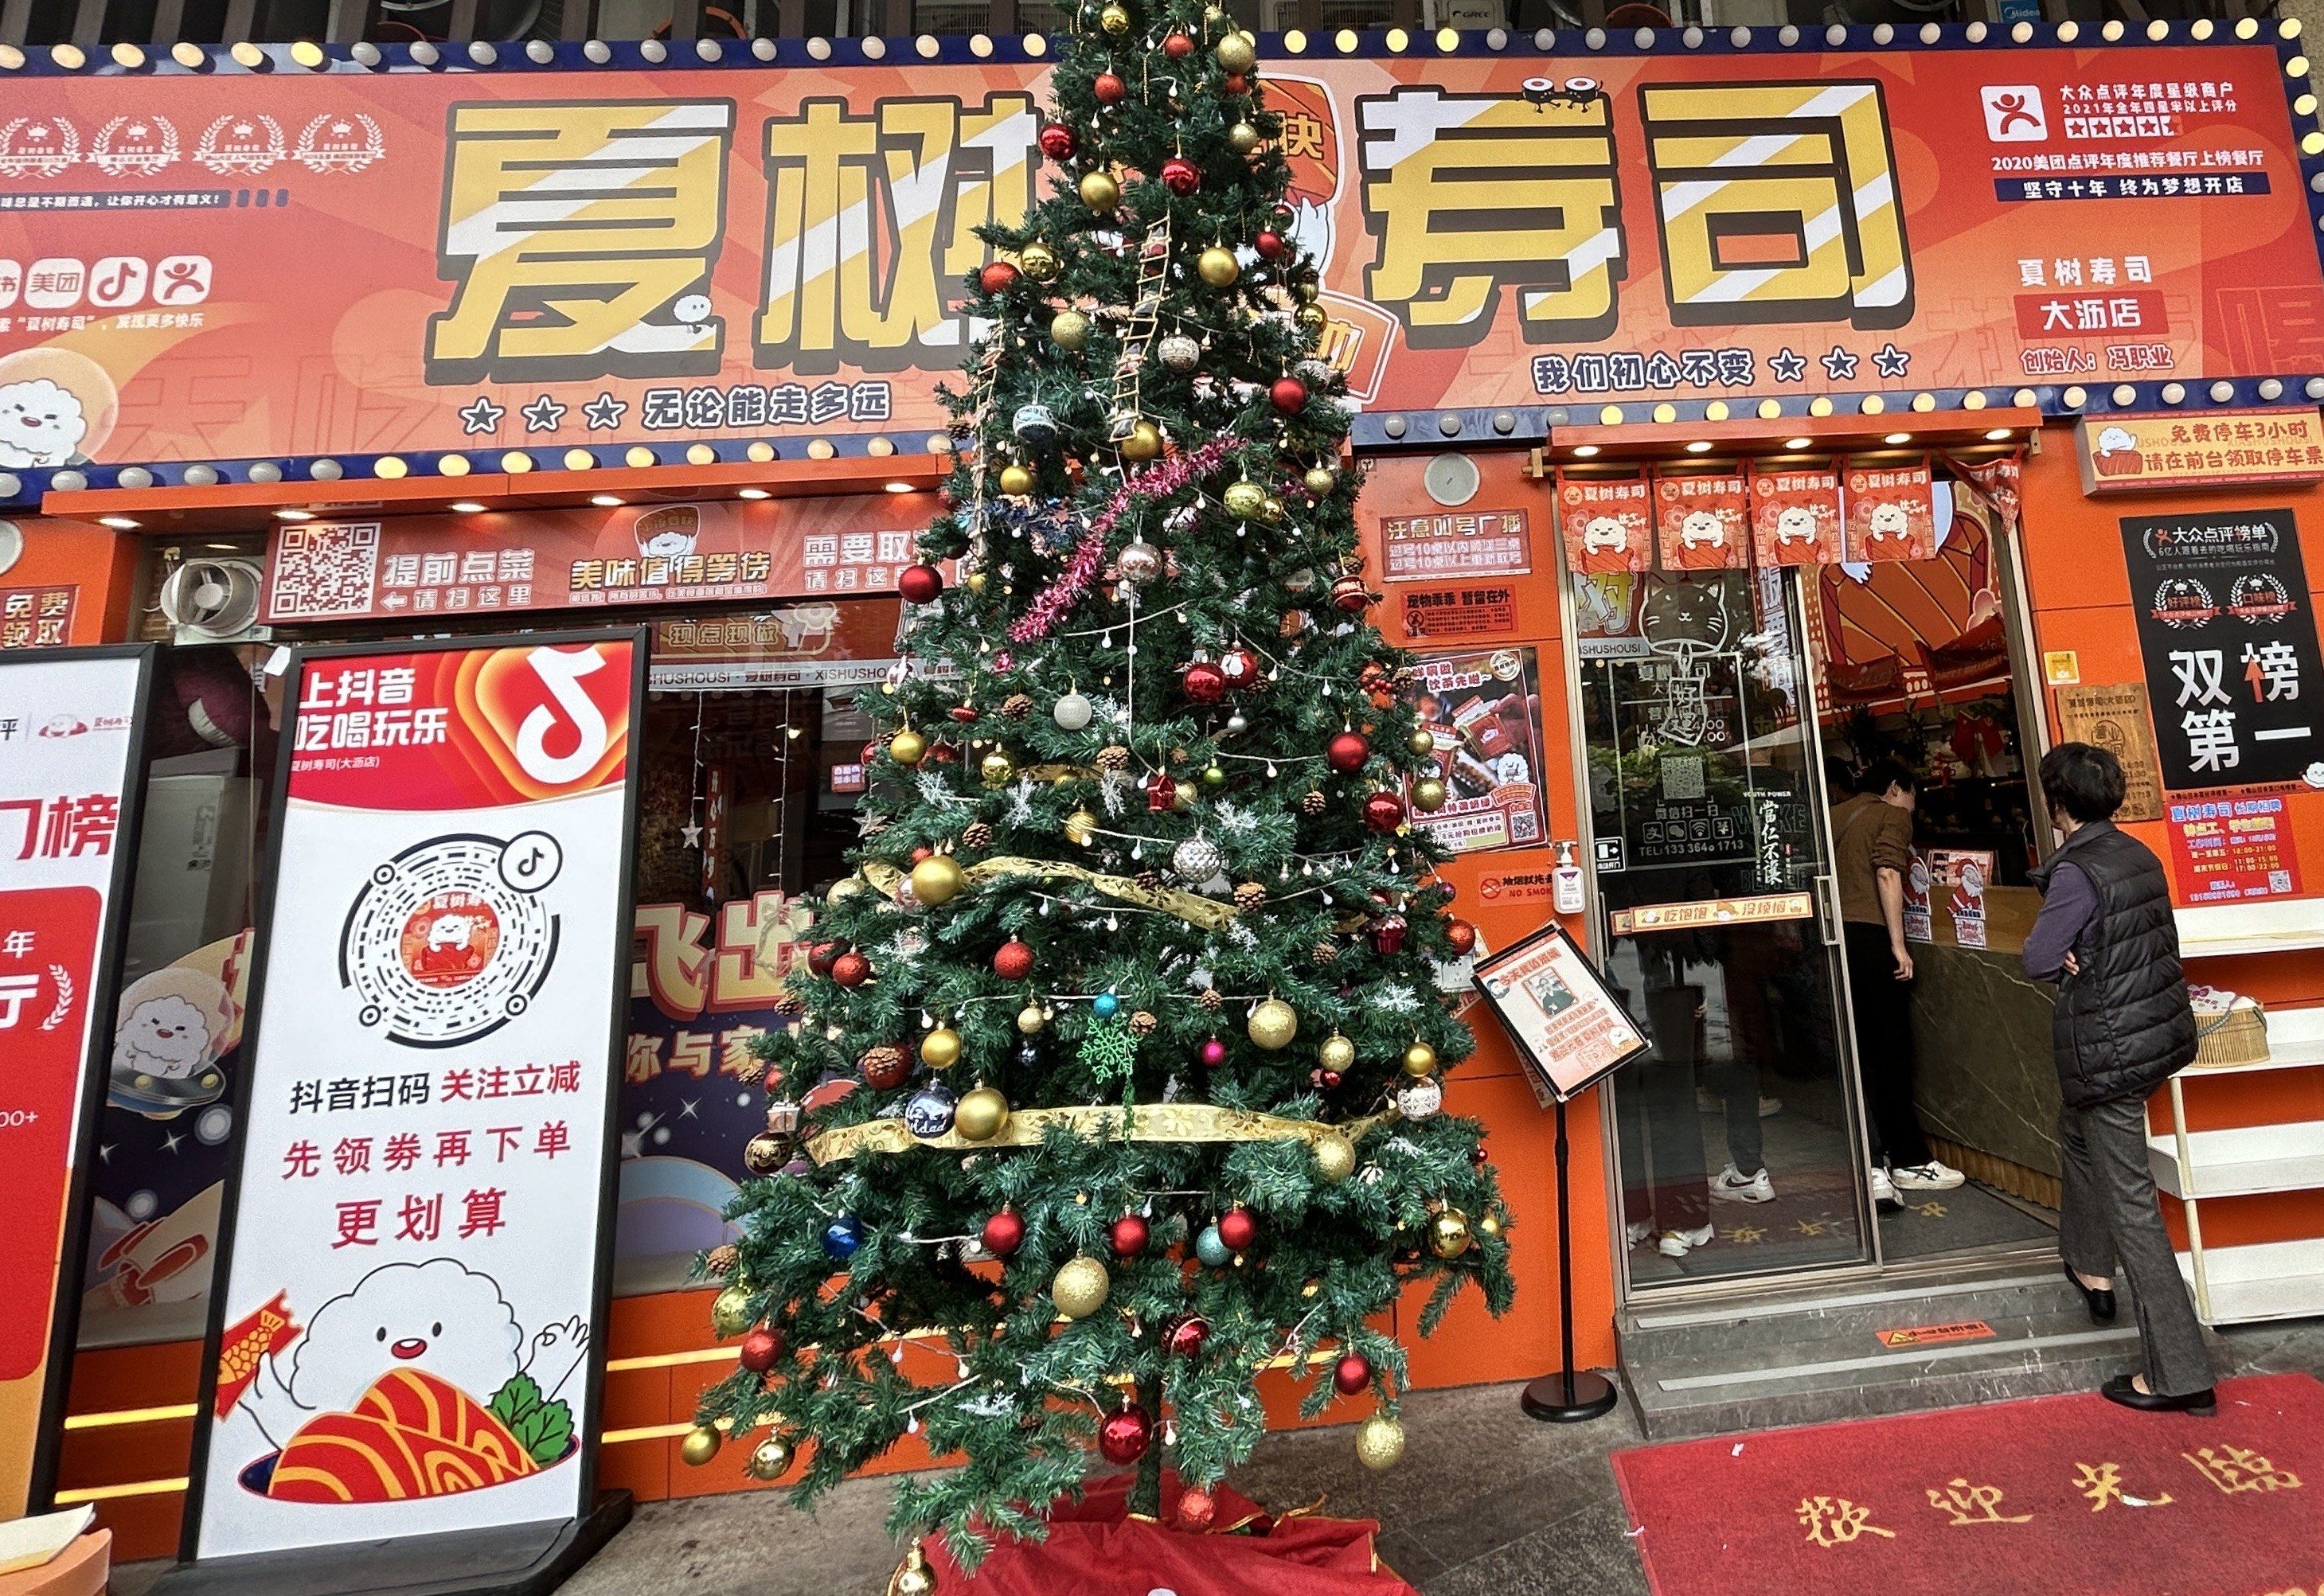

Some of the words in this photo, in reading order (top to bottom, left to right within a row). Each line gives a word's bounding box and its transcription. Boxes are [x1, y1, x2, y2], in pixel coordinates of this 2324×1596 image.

[2060, 80, 2234, 101] 大众点评年度星级商户
[2063, 100, 2238, 115] 2021年全年四星半以上评分
[1991, 150, 2264, 171] 2020美团点评年度推荐餐厅上榜餐厅
[2023, 180, 2108, 199] 坚守十年
[2119, 176, 2244, 197] 终为梦想开店
[1357, 82, 1912, 341] 寿司
[30, 271, 81, 294] 美团
[2017, 255, 2154, 287] 夏树寿司
[2040, 297, 2142, 331] 大沥店
[1533, 348, 1756, 392] 我们初心不变
[643, 380, 892, 430] 无论能走多远
[2170, 419, 2309, 443] 免费停车3小时
[2145, 444, 2324, 472] 请在前台领取停车票
[1584, 484, 1646, 501] 夏树寿司
[1681, 479, 1742, 497] 夏树寿司
[1775, 475, 1836, 492] 夏树寿司
[1867, 470, 1928, 488] 夏树寿司
[1387, 513, 1522, 540] 注意叫号广播
[2171, 524, 2267, 544] 大众点评榜单
[803, 530, 918, 567] 需要取
[382, 548, 536, 588] 提前点菜
[569, 550, 771, 591] 美味值得等待
[804, 568, 904, 591] 请扫这
[4, 591, 69, 619] 免费
[413, 584, 533, 611] 请扫这里
[299, 665, 417, 710] 上抖音
[293, 706, 450, 752] 吃喝玩乐
[2180, 708, 2313, 772] 第一
[1526, 887, 1553, 897] SMOK
[2, 930, 36, 959] 年
[289, 1071, 431, 1114] 抖音扫码
[439, 1059, 582, 1103] 关注立减
[330, 1186, 509, 1251] 更划算
